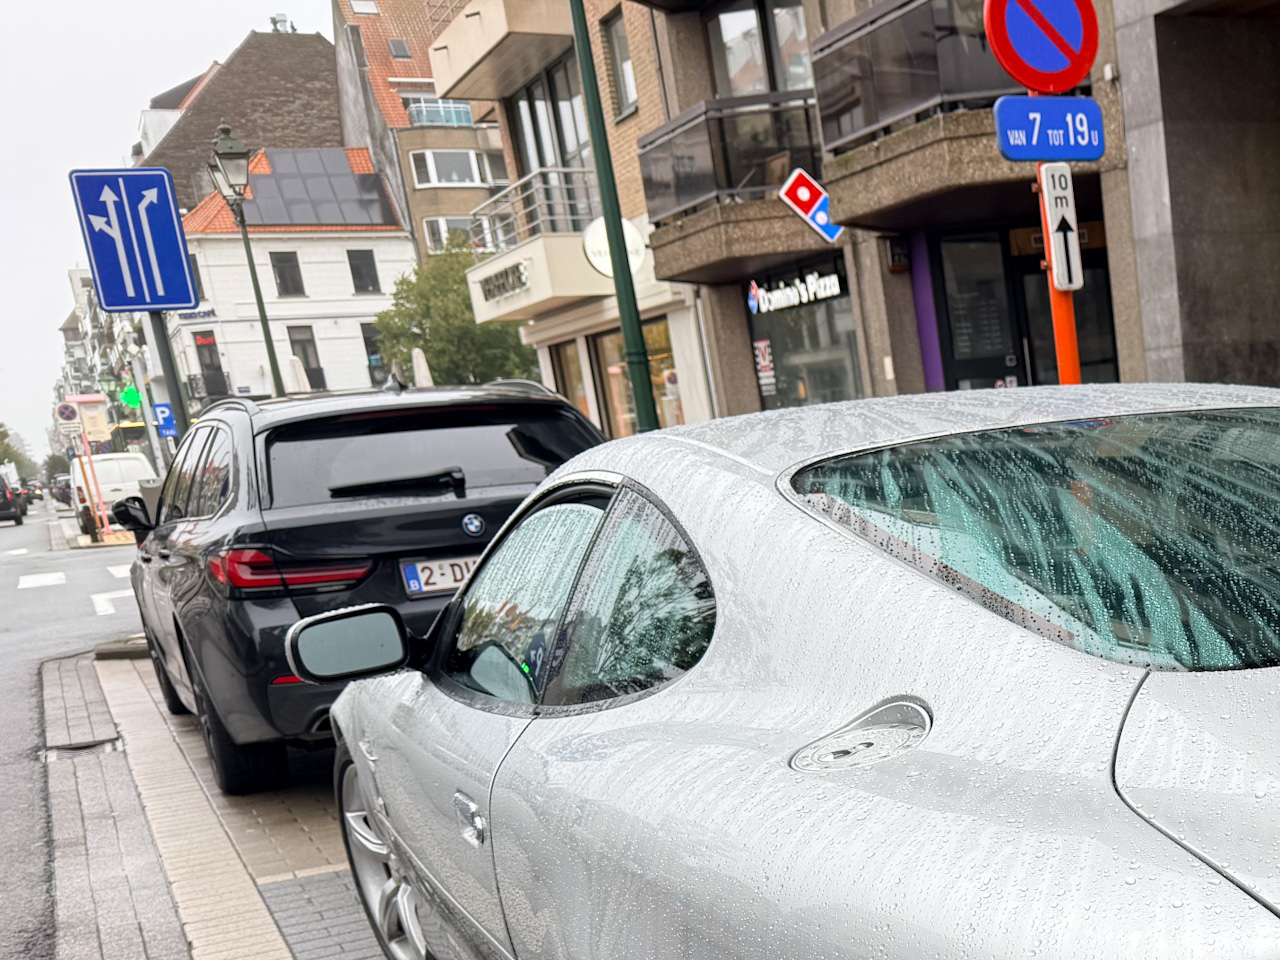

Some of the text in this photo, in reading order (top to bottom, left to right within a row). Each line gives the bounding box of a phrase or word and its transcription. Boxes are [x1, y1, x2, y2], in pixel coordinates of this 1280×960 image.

[1007, 112, 1099, 147] VAN 7 TOT 19 U
[1051, 173, 1068, 191] 10
[1054, 195, 1069, 209] m
[757, 271, 841, 313] Domino's Pizza
[155, 406, 170, 425] P
[409, 579, 420, 591] B
